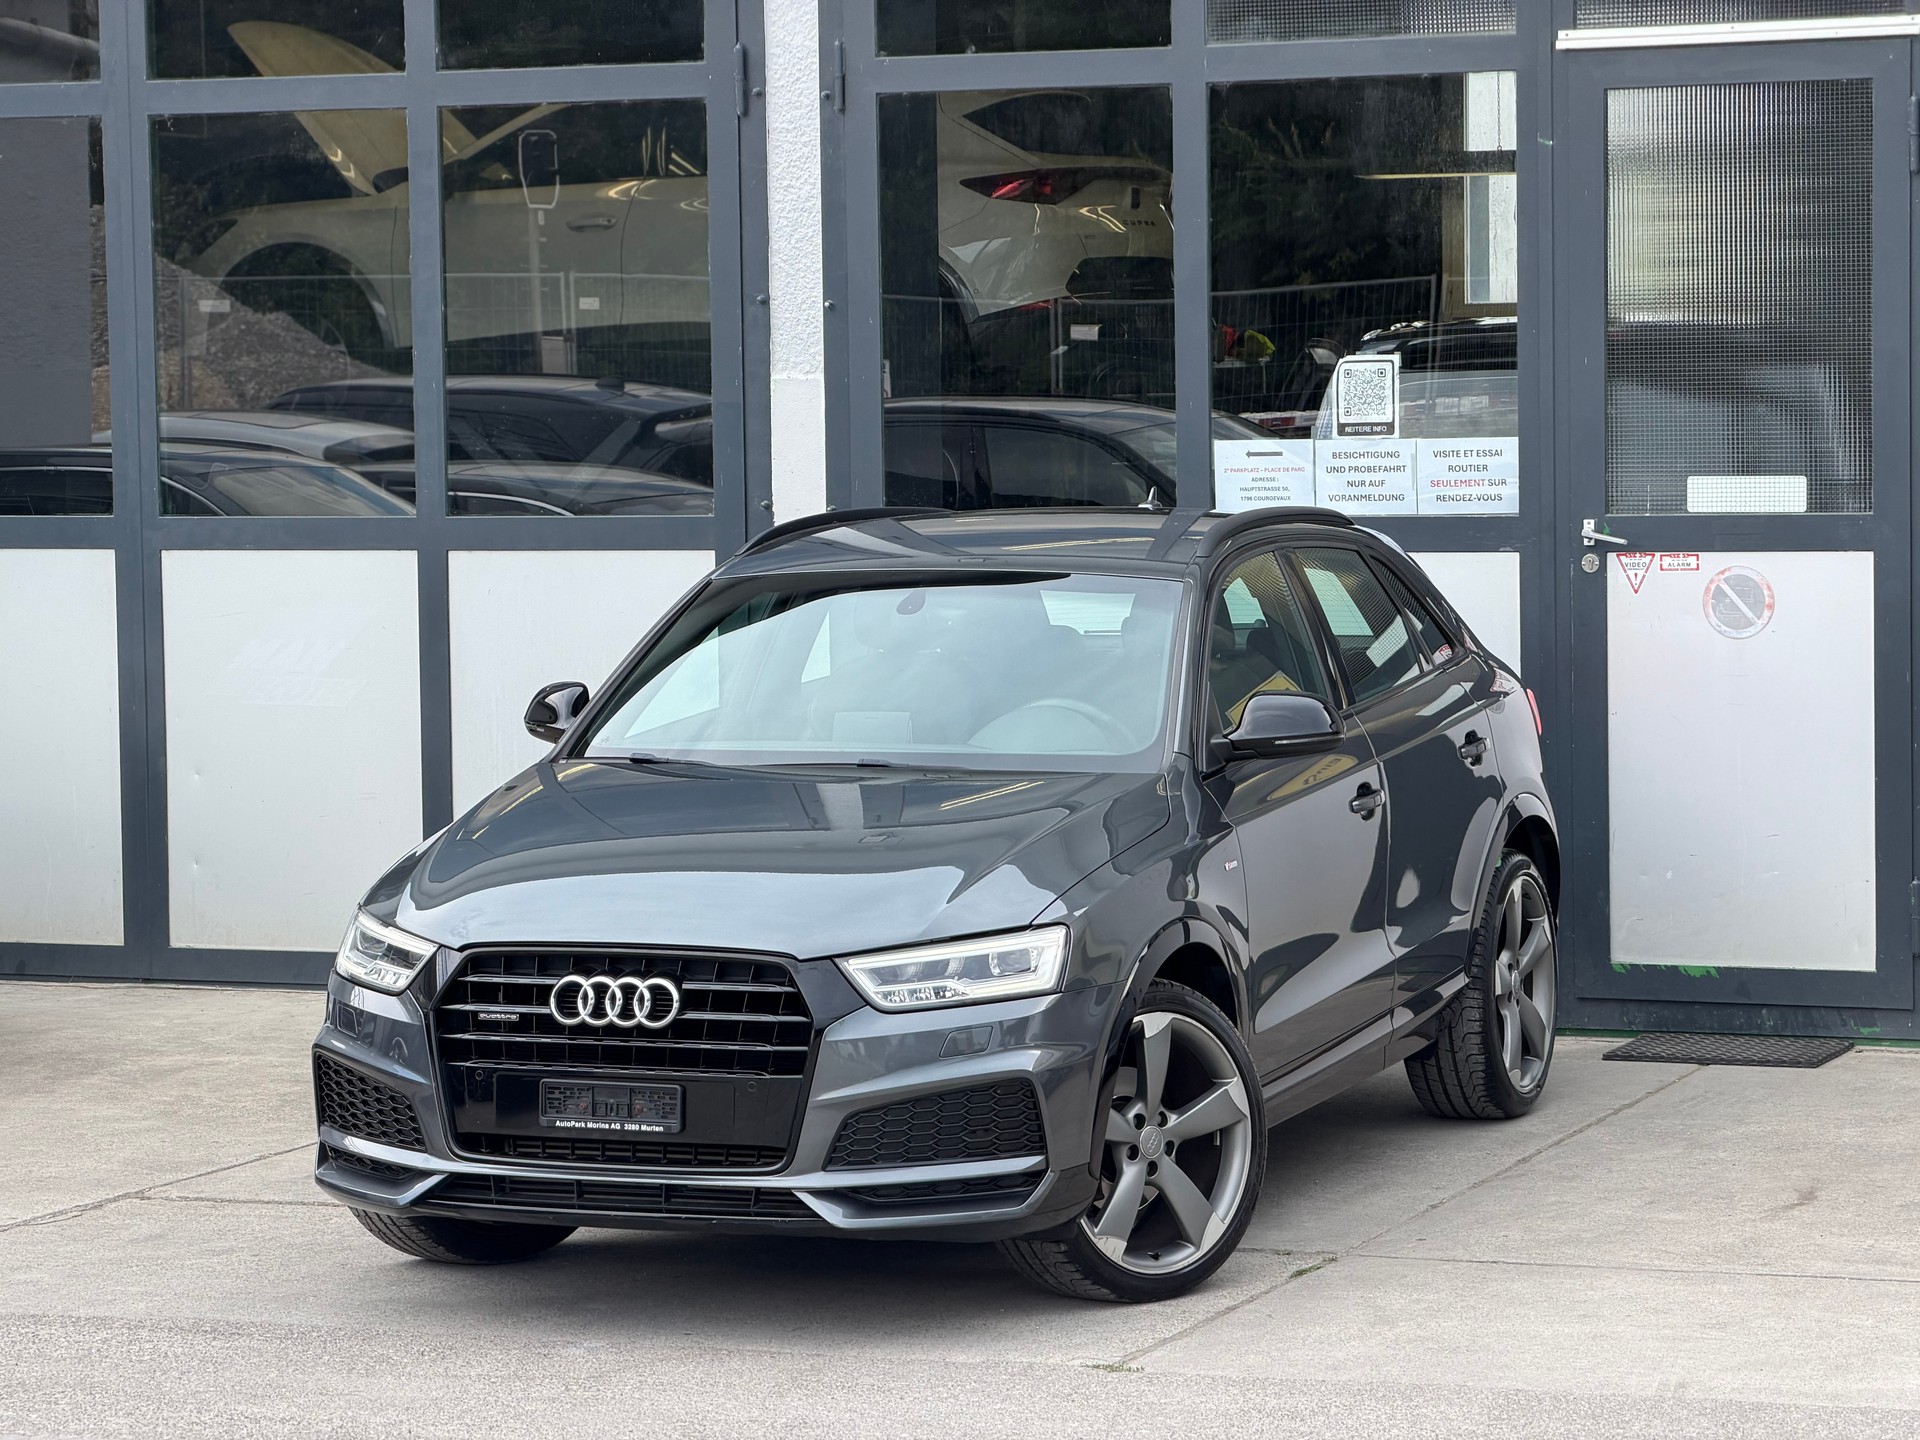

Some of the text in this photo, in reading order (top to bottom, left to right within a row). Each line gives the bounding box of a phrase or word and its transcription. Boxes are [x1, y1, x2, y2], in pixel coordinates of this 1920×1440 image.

[1331, 450, 1401, 460] BESICHTIGUNG
[1432, 448, 1503, 459] VISITE ET ESSAI
[1325, 464, 1407, 474] UND PROBEFAHRT
[1447, 463, 1489, 473] ROUTIER
[1346, 479, 1386, 488] NUR AUF
[1429, 477, 1508, 488] SEULEMENT SUR
[1327, 493, 1406, 502] VORANMELDUNG
[1435, 493, 1503, 503] RENDEZ-VOUS
[555, 1119, 664, 1132] AutoPark Morina AG 3280 Murten
